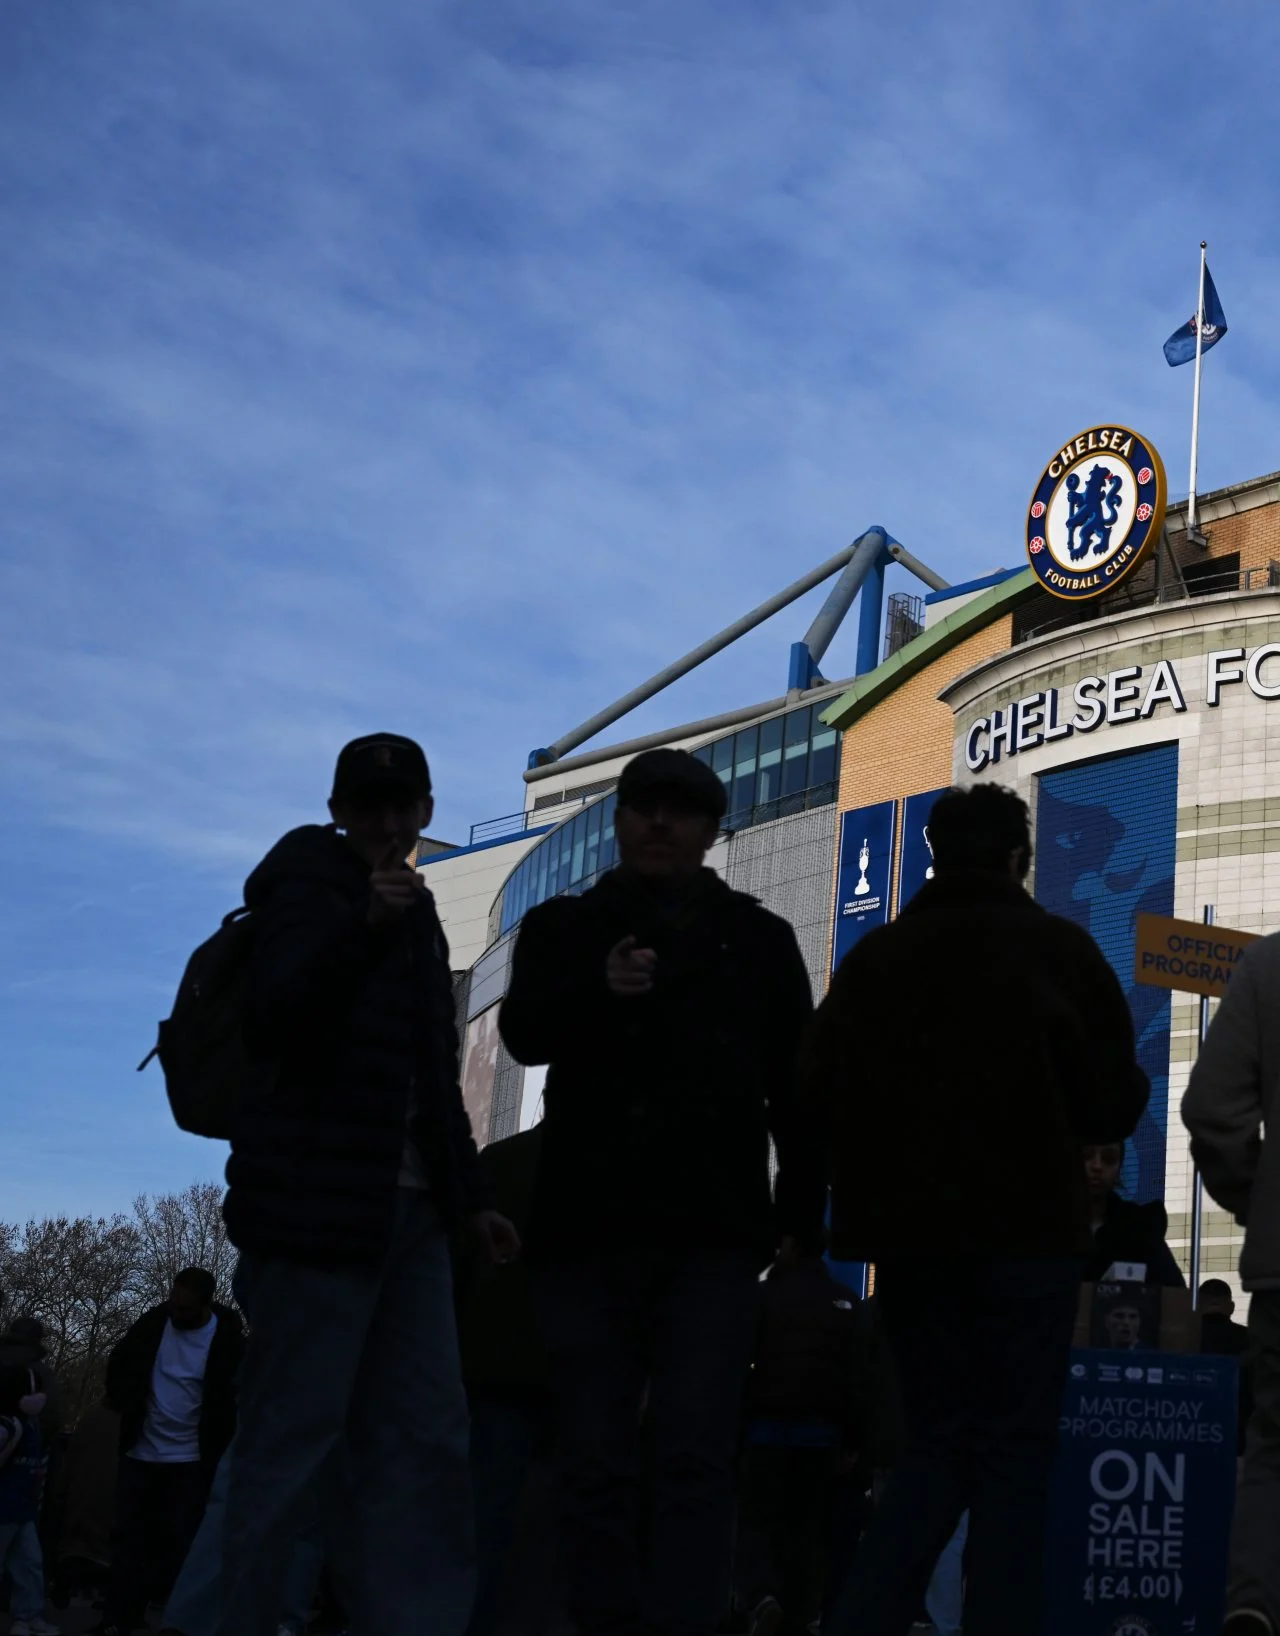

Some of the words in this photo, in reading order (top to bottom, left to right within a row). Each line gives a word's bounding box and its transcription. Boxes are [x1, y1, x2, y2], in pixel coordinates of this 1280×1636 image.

[1048, 430, 1133, 478] CHELSEA
[1045, 568, 1101, 590] FOOTBALL
[1105, 544, 1133, 576] CLUB
[965, 660, 1187, 773] CHELSEA
[1167, 934, 1244, 963] OFFICIA
[1142, 951, 1231, 985] PROGRA
[1079, 1395, 1204, 1421] MATCHDAY
[1058, 1416, 1224, 1443] PROGRAMMES
[1089, 1448, 1186, 1503] ON
[1088, 1503, 1185, 1537] SALE
[1086, 1537, 1183, 1569] HERE
